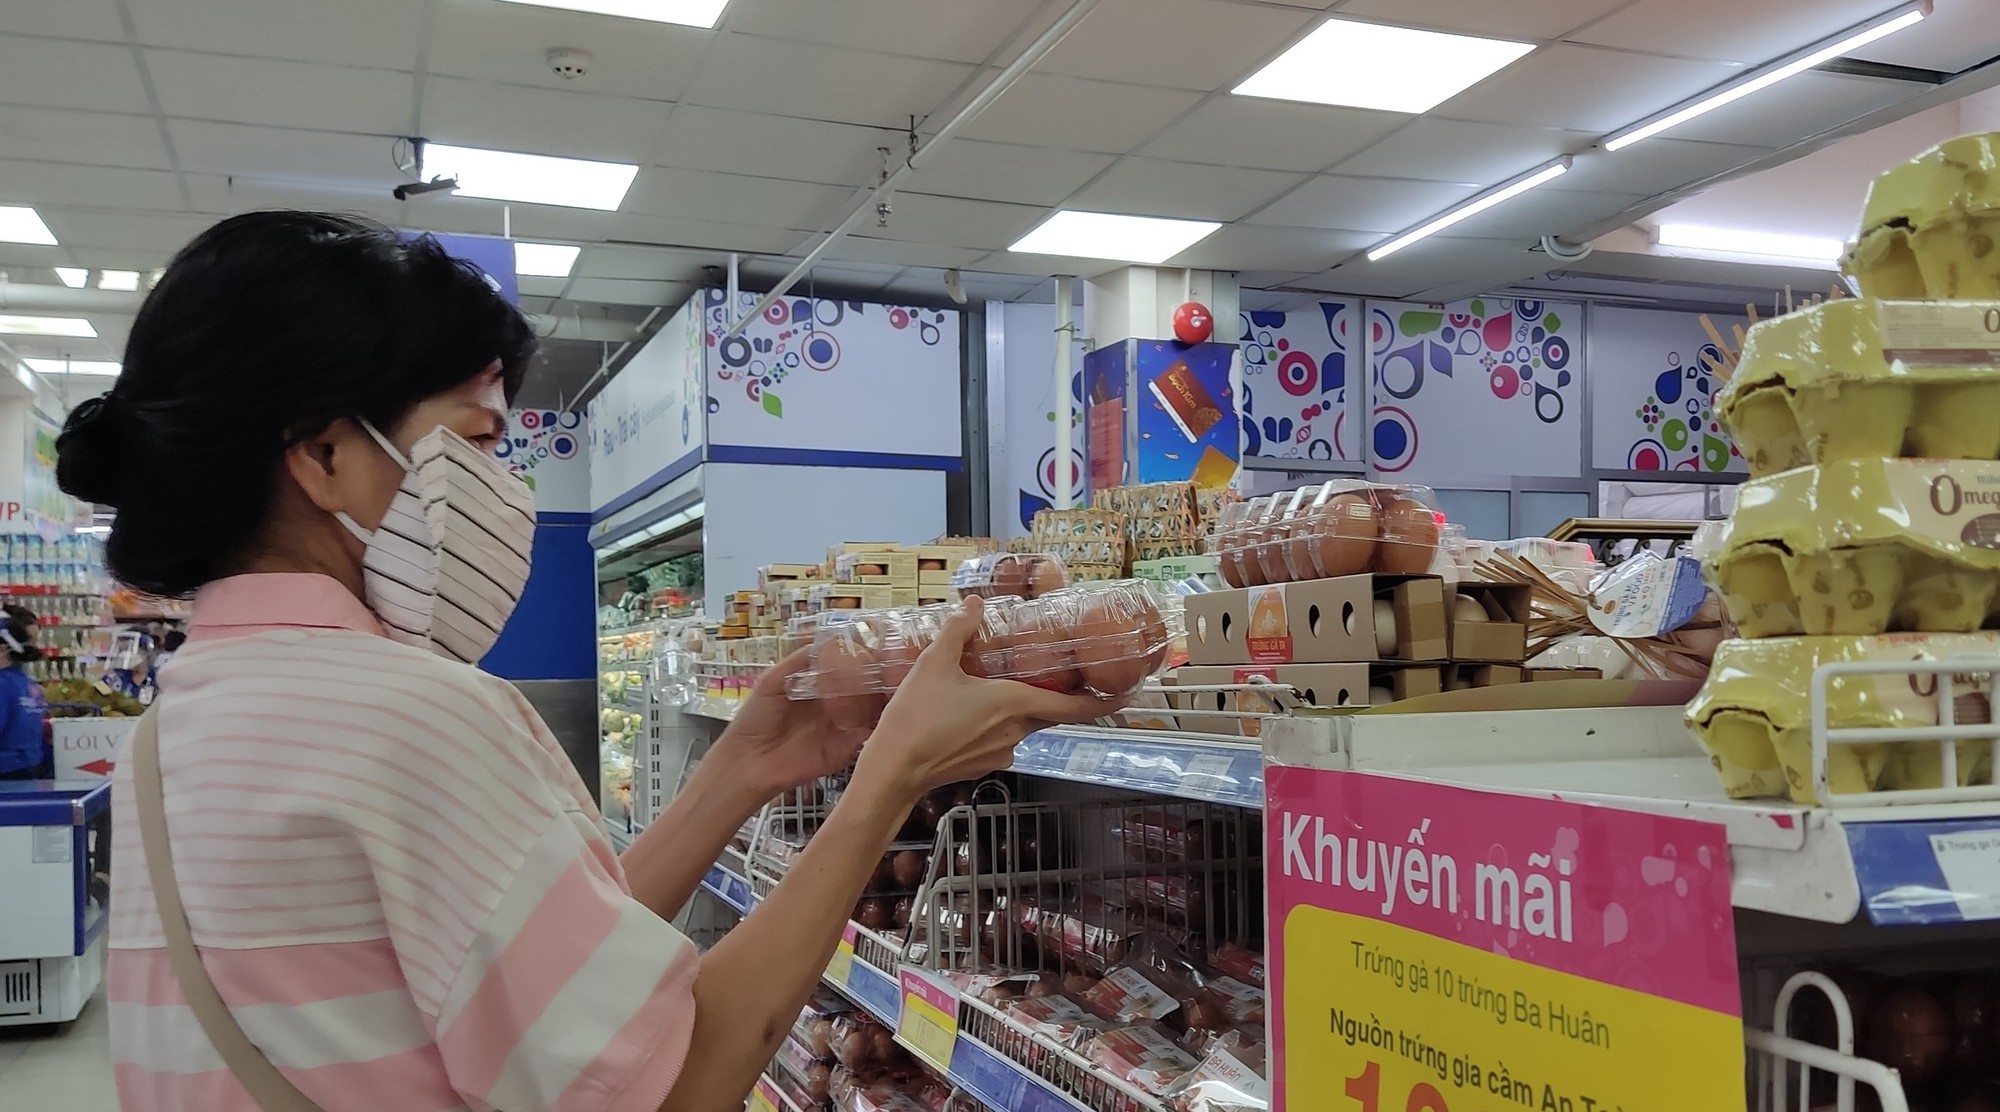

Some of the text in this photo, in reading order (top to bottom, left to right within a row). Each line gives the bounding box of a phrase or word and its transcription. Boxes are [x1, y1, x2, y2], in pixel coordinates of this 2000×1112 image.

[1283, 810, 1574, 944] Khuyến mãi
[1350, 940, 1610, 1050] Trứng gà 10 trứng Ba Huân
[1207, 1055, 1223, 1070] BA
[1218, 1062, 1241, 1081] HUÂN
[1330, 1006, 1574, 1112] Nguồn trứng gia cầm An
